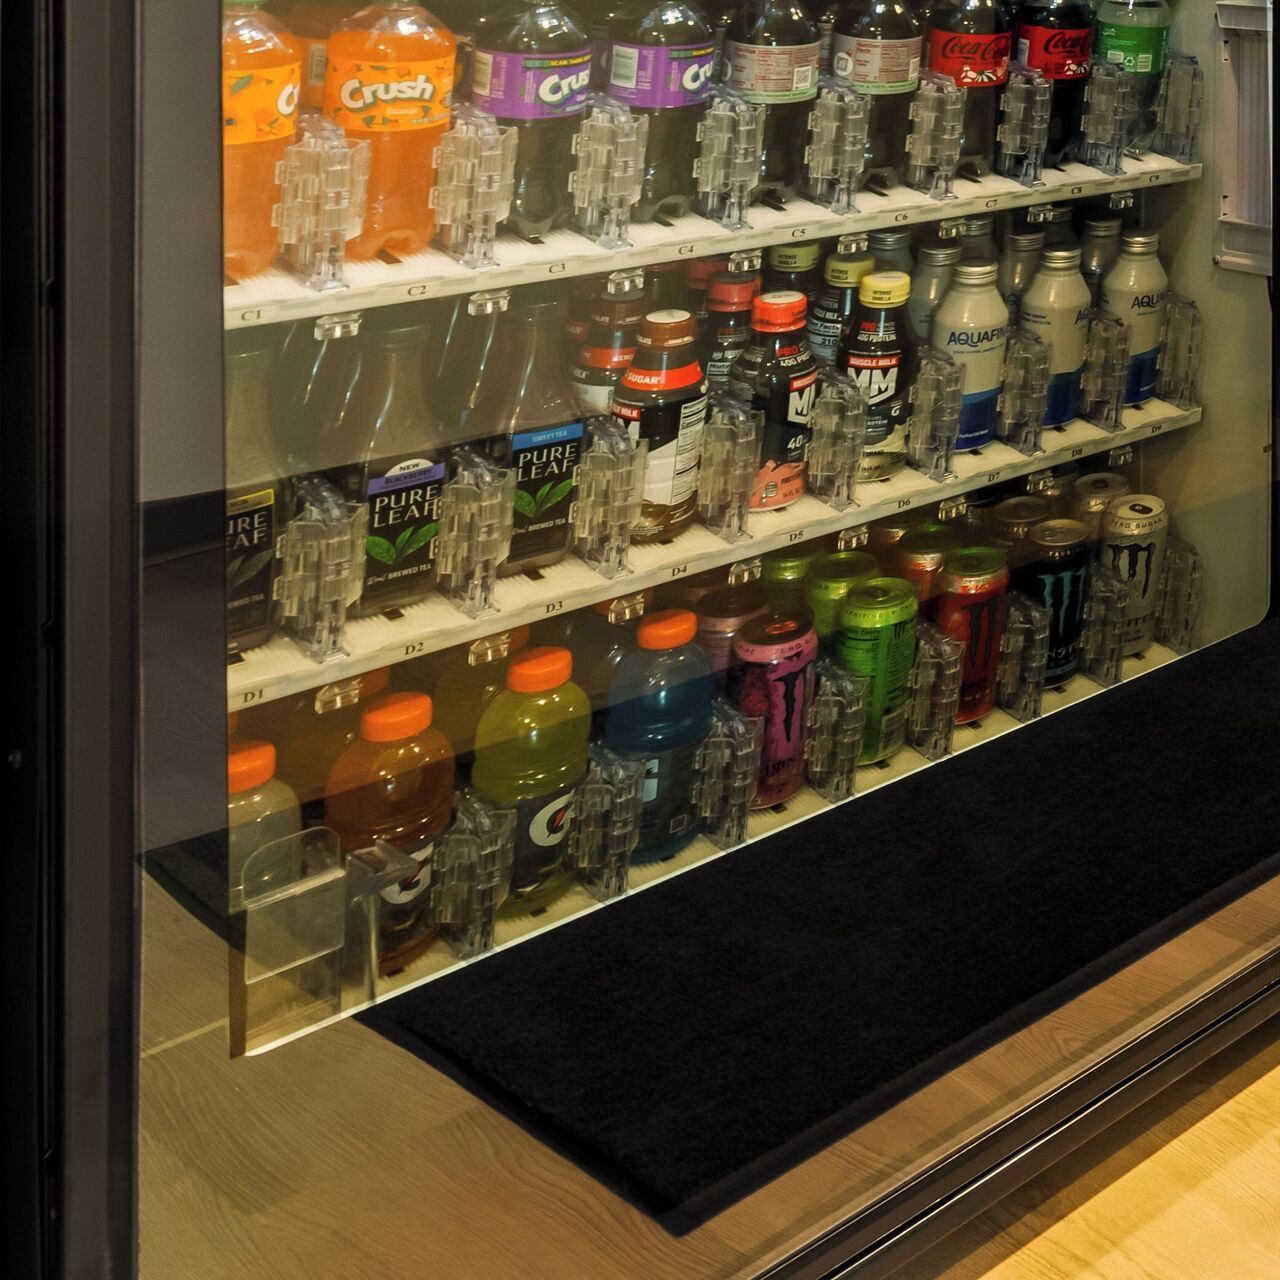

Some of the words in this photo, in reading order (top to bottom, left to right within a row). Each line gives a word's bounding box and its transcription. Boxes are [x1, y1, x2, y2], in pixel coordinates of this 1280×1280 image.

[538, 69, 590, 103] Crus
[682, 60, 714, 91] Cru
[339, 74, 434, 111] Crush
[241, 310, 261, 322] C1
[407, 285, 427, 296] C2
[548, 263, 567, 274] C3
[678, 245, 694, 255] C4
[791, 229, 806, 238] C5
[894, 213, 908, 222] C6
[985, 199, 998, 208] C7
[776, 345, 798, 356] PRO
[399, 462, 421, 472] NEW
[518, 443, 578, 467] PURE
[517, 457, 576, 482] LEAF
[375, 484, 439, 513] PURE
[528, 521, 554, 532] BREWED
[388, 566, 419, 580] BREWED
[419, 563, 432, 572] TEA
[243, 689, 265, 704] D1
[403, 641, 425, 657] D2
[545, 601, 564, 614] D3
[671, 565, 688, 577] D4
[789, 531, 804, 542] D5
[897, 498, 912, 508] D6
[987, 472, 1001, 482] D7
